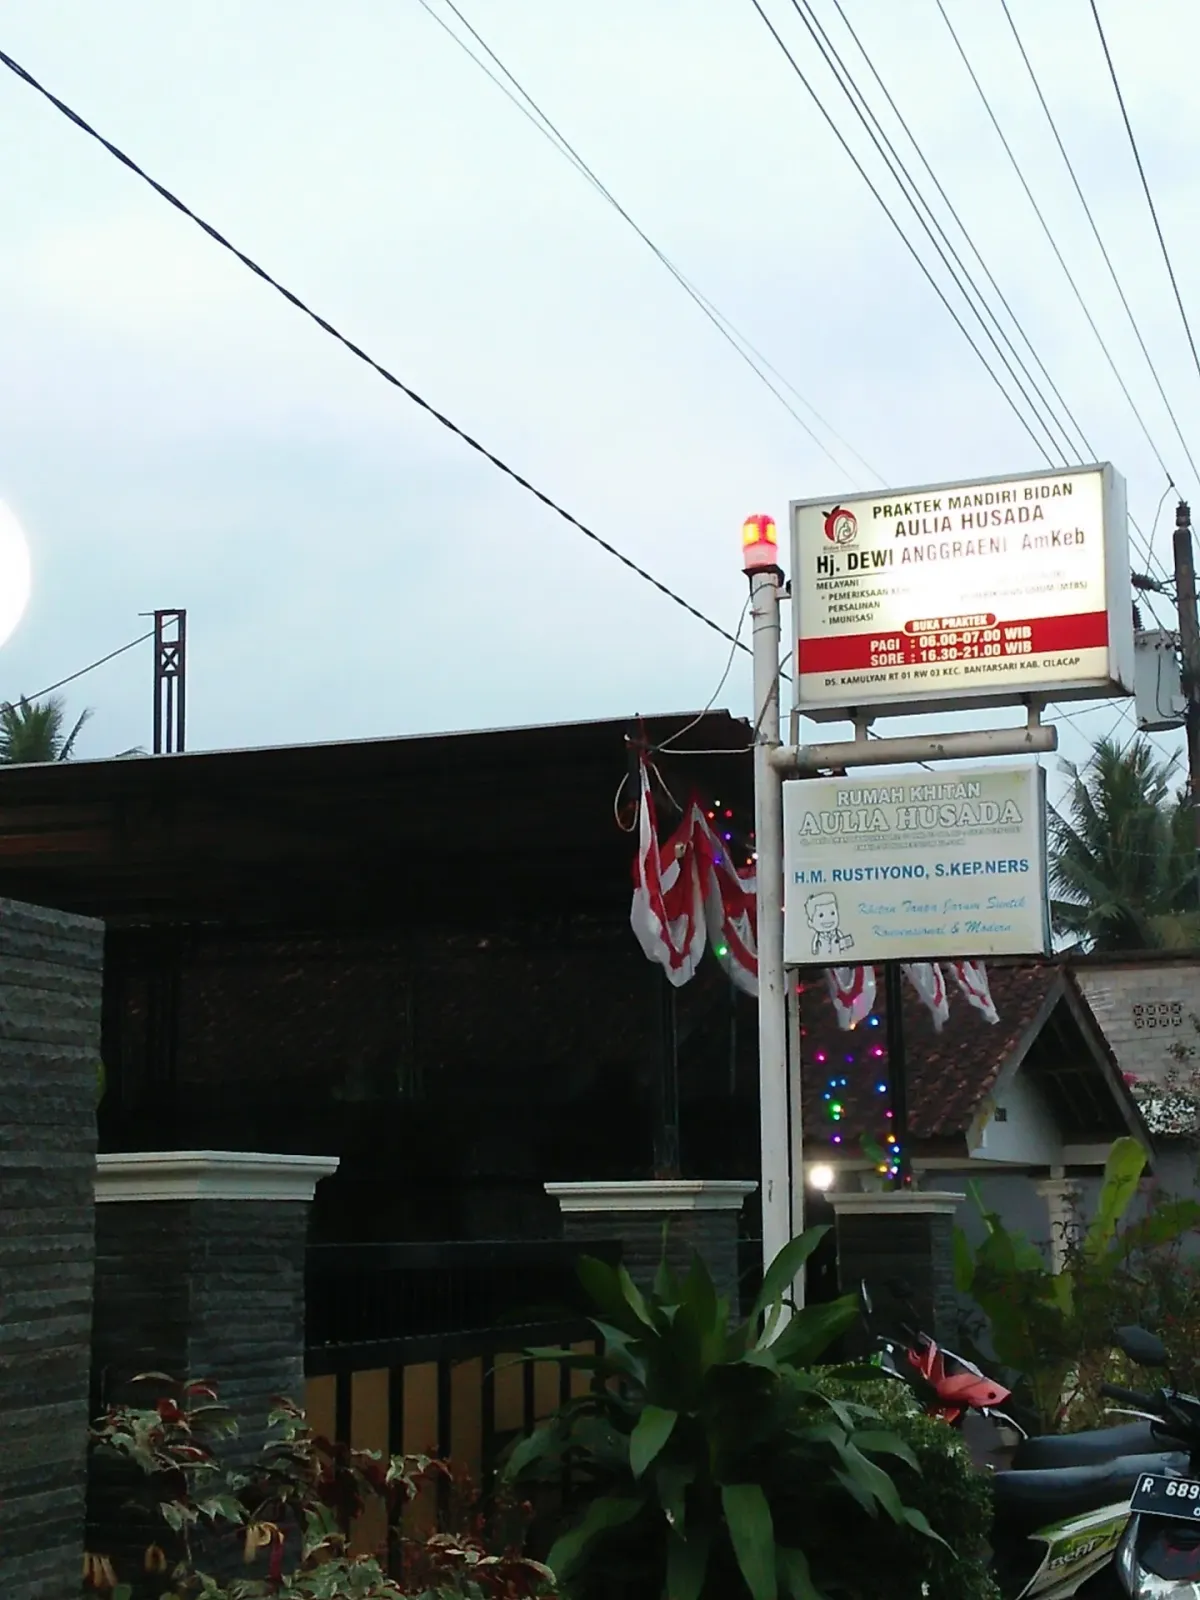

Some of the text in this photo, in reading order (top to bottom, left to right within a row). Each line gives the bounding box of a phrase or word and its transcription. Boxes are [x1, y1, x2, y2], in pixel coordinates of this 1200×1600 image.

[873, 482, 1073, 519] PRAKTEK MANDIRI BIDAN
[895, 504, 1045, 538] AULIA HUSADA
[816, 555, 840, 576] Hj.
[847, 548, 893, 571] DEWI
[901, 536, 1007, 564] ANGGRAENI
[816, 580, 859, 590] MELAYANI
[828, 589, 888, 601] PEMERIKSAAN
[828, 601, 880, 613] PERSALINAN
[828, 613, 874, 625] IMUNISASI
[912, 614, 988, 632] BUKA PRAKTEK
[870, 638, 900, 653] PAGI
[919, 629, 1001, 648] 06.00-07.00
[1004, 626, 1032, 640] WIB
[870, 652, 905, 667] SORE
[920, 644, 1001, 662] 16.30-21.00
[1004, 641, 1032, 655] WIB
[841, 674, 887, 685] KAMULYAN
[889, 672, 899, 680] RT
[901, 671, 911, 679] 01
[914, 669, 928, 678] RW
[964, 662, 1017, 674] BANTARSARI
[1020, 660, 1040, 669] KAB.
[1042, 657, 1081, 668] CILACAP
[837, 782, 981, 807] RUMAH KHITAN
[798, 808, 890, 836] AULIA
[896, 799, 1023, 831] HUSADA
[794, 859, 1029, 884] H.M. RUSTIYONO, S.KEP.NERS
[1141, 1477, 1200, 1500] R 689
